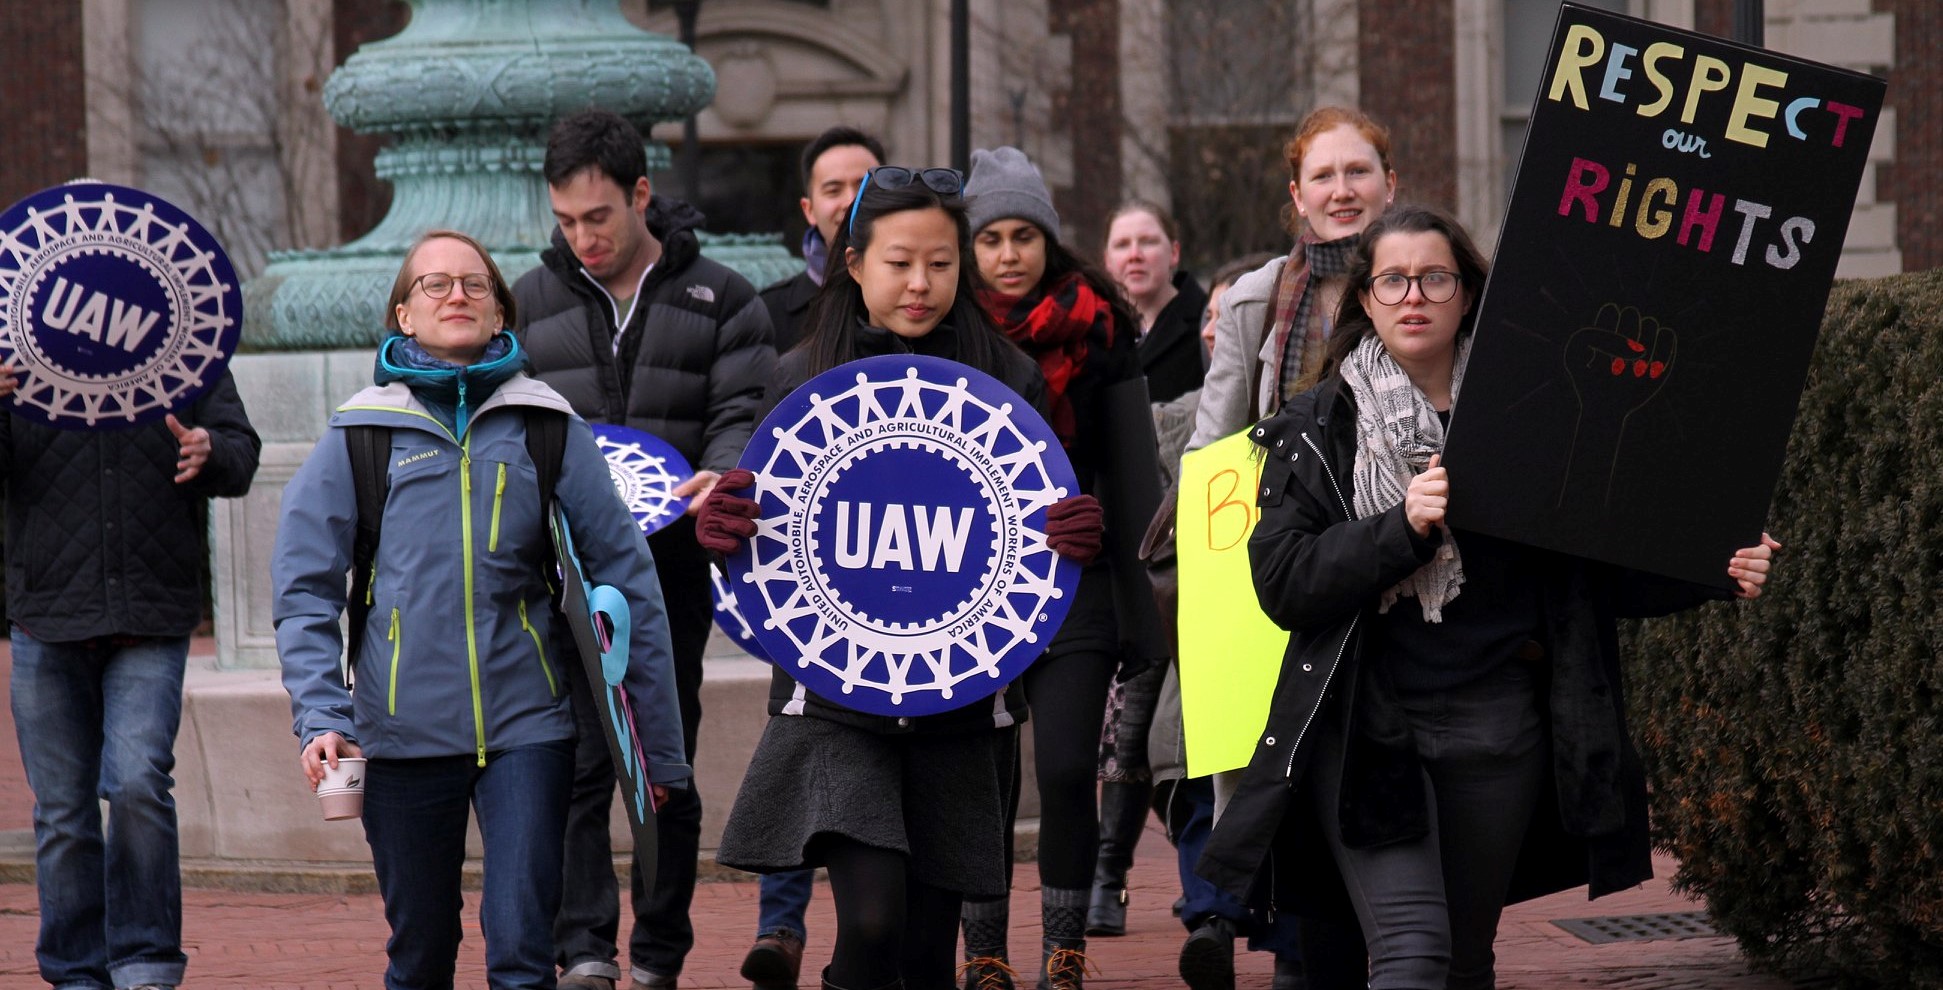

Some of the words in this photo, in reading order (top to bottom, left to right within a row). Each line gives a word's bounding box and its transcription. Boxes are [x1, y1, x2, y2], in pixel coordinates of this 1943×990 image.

[1548, 24, 1865, 148] RESPECT
[1662, 128, 1711, 159] our
[29, 237, 77, 270] AEROSPACE
[82, 233, 104, 243] AND
[108, 235, 172, 274] AGRICULTURAL
[42, 276, 160, 353] UAW
[164, 326, 189, 363] WORKERS
[107, 373, 149, 391] AMERICA
[153, 364, 164, 374] OF
[847, 428, 873, 446] AND
[878, 422, 968, 451] AGRICULTURAL
[397, 449, 439, 467] MAMMUT
[798, 443, 843, 504] AEROSPACE
[969, 447, 1014, 509] IMPLEMENT
[792, 508, 815, 592] AUTOMOBILE,
[835, 501, 975, 573] UAW
[1003, 515, 1018, 575] WORKERS
[994, 580, 1006, 596] OF
[812, 594, 849, 631] UNITED
[947, 598, 994, 638] AMERICA
